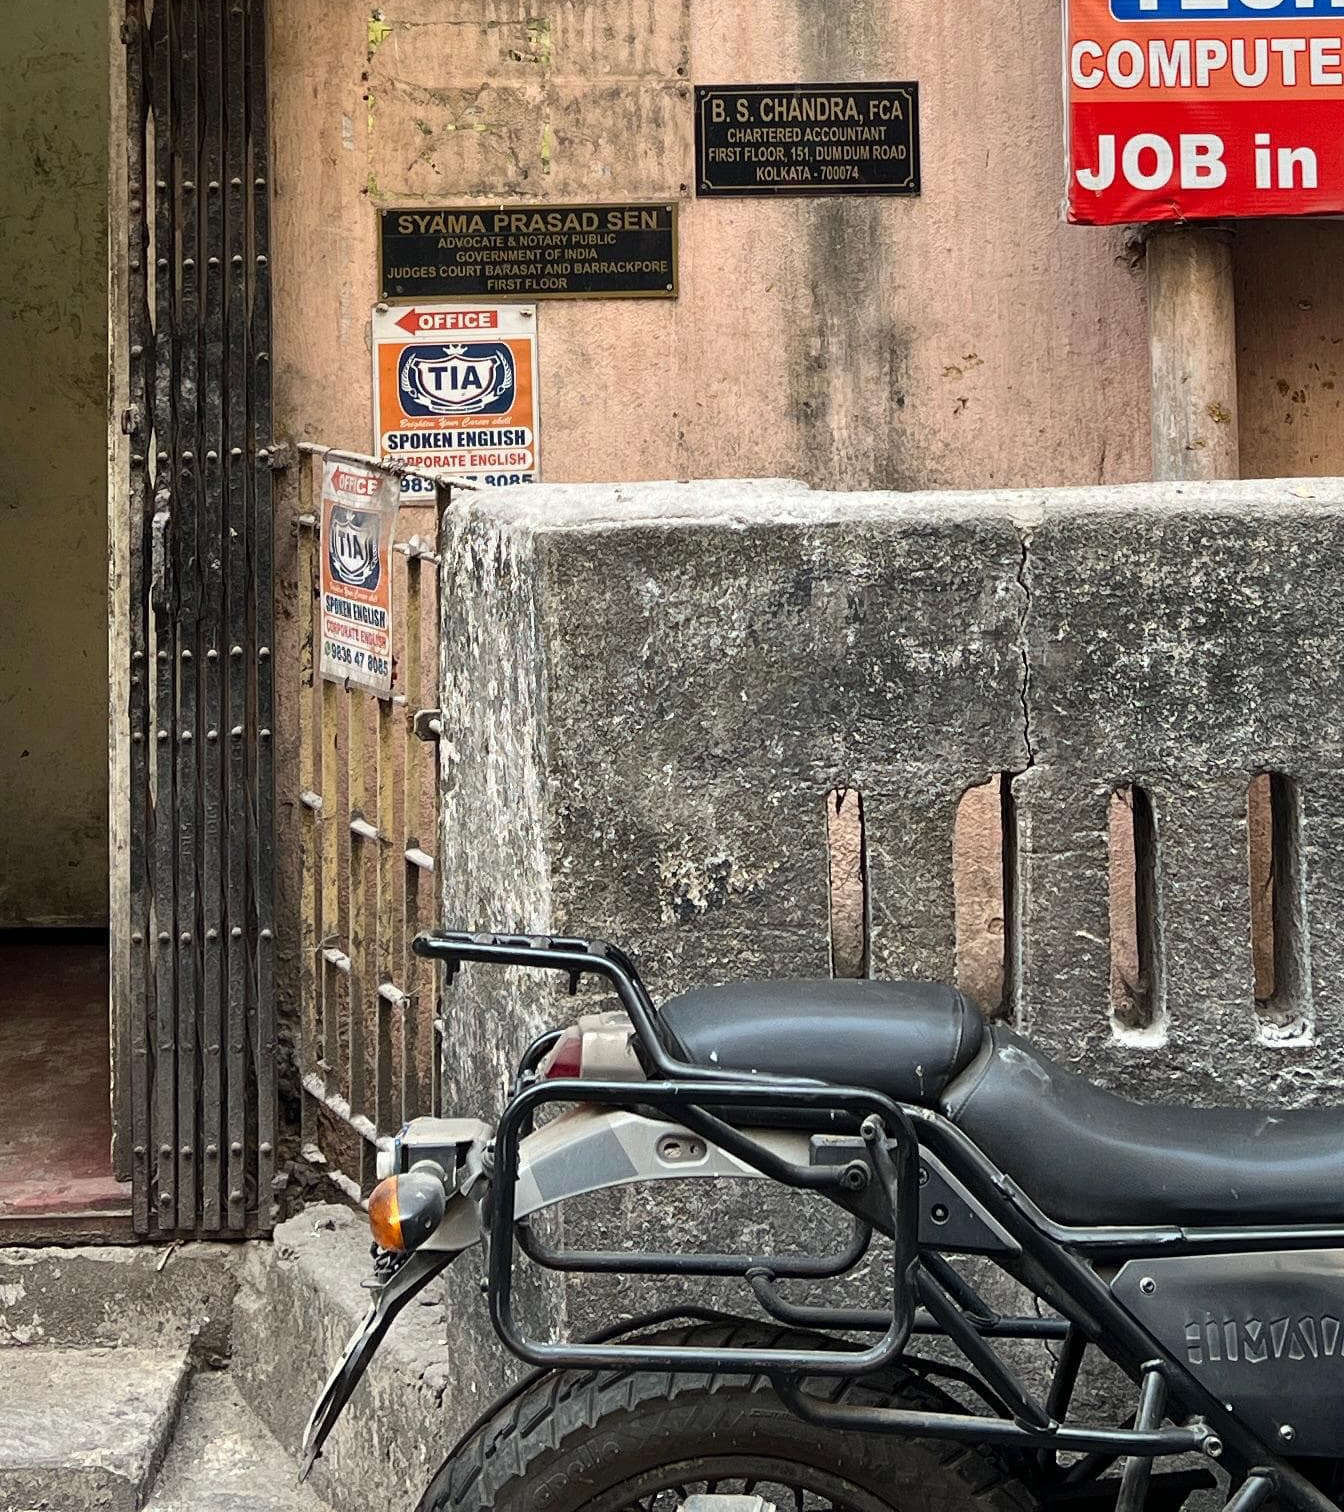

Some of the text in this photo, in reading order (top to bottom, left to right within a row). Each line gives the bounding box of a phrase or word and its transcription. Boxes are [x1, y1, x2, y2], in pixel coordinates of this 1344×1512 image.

[712, 98, 903, 123] B. S. CHANDRA, FCA
[727, 126, 887, 143] CHARTERED ACCOUNTANT
[1076, 134, 1228, 192] JOB
[1254, 132, 1318, 188] in
[397, 210, 657, 234] SYAMA PRASAD SEN
[418, 312, 491, 329] OFFICE
[388, 430, 526, 450] SPOKEN ENGLISH
